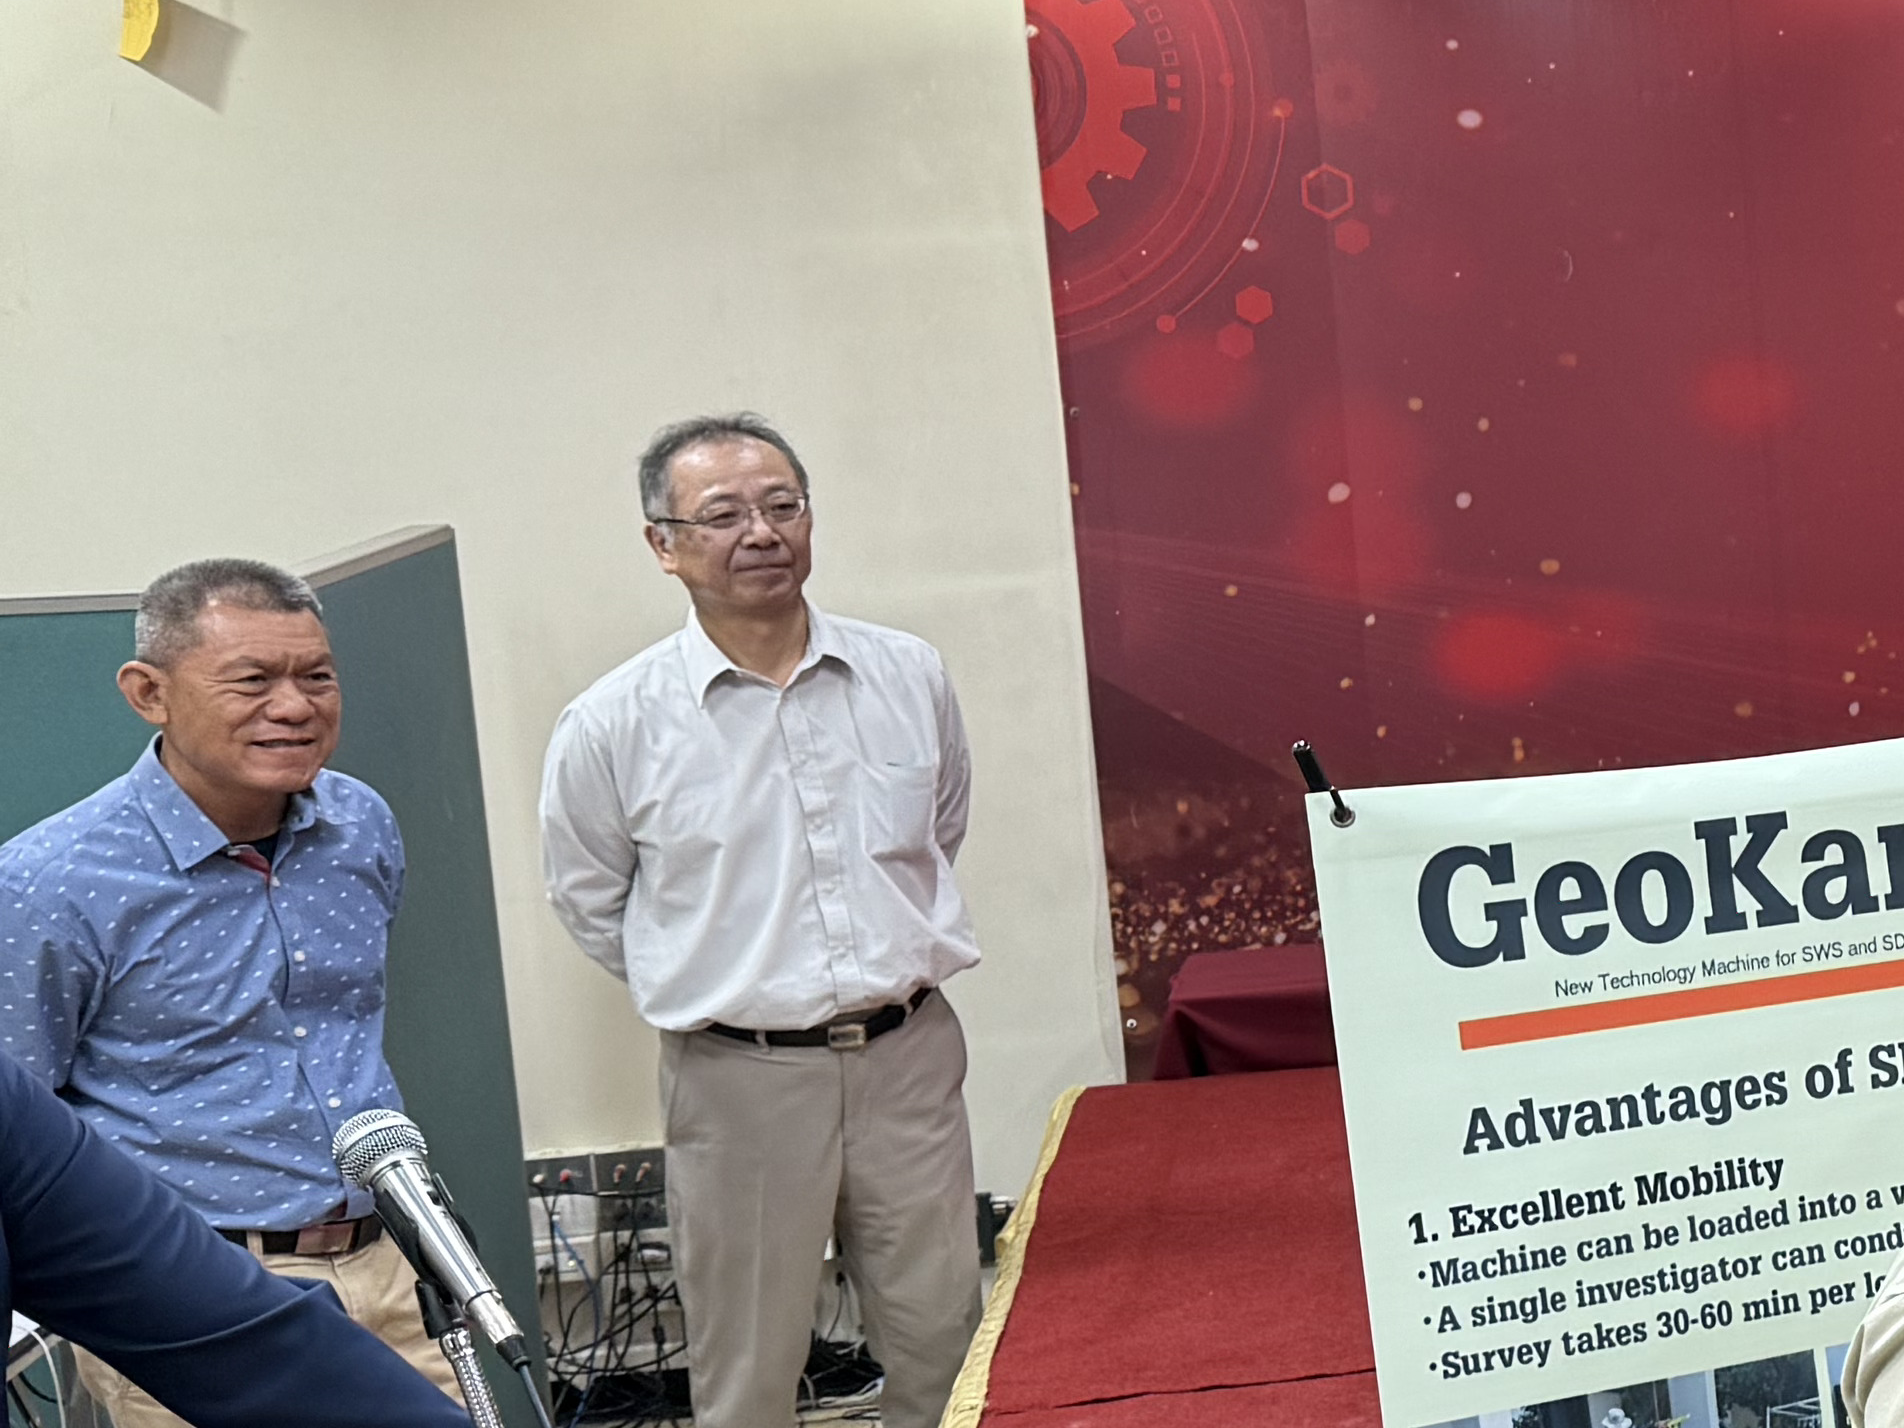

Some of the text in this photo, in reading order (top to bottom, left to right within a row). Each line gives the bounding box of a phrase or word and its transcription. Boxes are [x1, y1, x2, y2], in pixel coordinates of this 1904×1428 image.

[1555, 980, 1593, 998] New
[1598, 966, 1696, 991] Technology
[1701, 956, 1770, 977] Machine
[1775, 952, 1796, 967] for
[1802, 941, 1843, 963] SWS
[1848, 936, 1877, 956] and
[1463, 1070, 1788, 1155] Advantages
[1805, 1047, 1855, 1099] of
[1408, 1157, 1784, 1245] 1. Excellent Mobility
[1429, 1244, 1567, 1288] Machine
[1576, 1233, 1635, 1262] can
[1641, 1222, 1680, 1251] be
[1687, 1198, 1790, 1243] loaded
[1798, 1193, 1857, 1223] into
[1866, 1189, 1883, 1210] a
[1437, 1305, 1462, 1334] A
[1471, 1287, 1567, 1328] single
[1575, 1254, 1762, 1308] investigator
[1771, 1244, 1826, 1272] can
[1441, 1339, 1552, 1380] Survey
[1561, 1322, 1648, 1356] takes
[1656, 1300, 1733, 1338] 30-60
[1742, 1289, 1801, 1322] min
[1808, 1281, 1856, 1315] per
